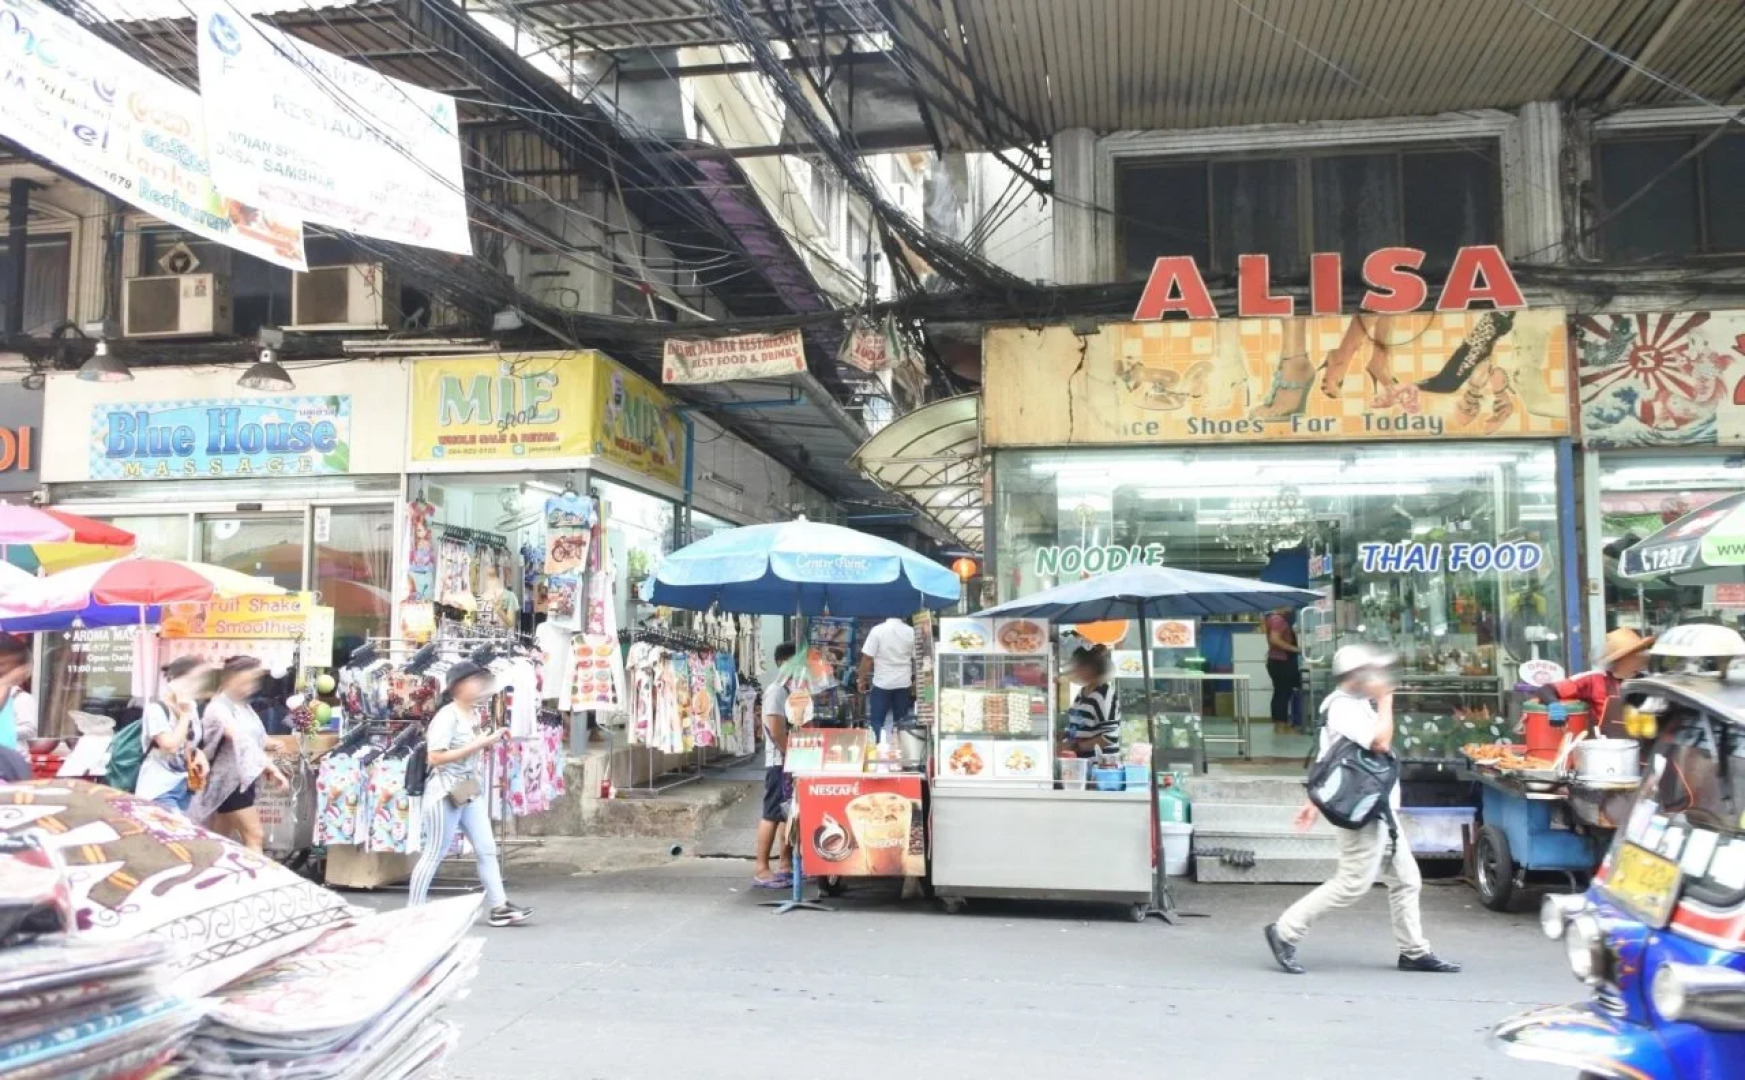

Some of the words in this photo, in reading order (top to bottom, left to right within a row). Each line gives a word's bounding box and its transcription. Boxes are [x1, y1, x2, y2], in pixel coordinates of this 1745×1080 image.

[1133, 244, 1528, 321] ALISA
[717, 355, 747, 366] FOOD
[438, 371, 560, 427] MIE
[496, 406, 539, 433] shop
[1187, 416, 1264, 435] Shoes
[1291, 414, 1337, 433] For
[1363, 411, 1444, 435] Today
[105, 411, 196, 459] Blue
[205, 407, 338, 457] House
[123, 457, 314, 477] MASSAGE
[1034, 541, 1164, 577] NOODLE
[1357, 541, 1442, 573] THAI
[1449, 541, 1544, 573] FOOD
[73, 629, 110, 641] AROMA
[215, 619, 306, 635] Smoothies
[87, 653, 110, 663] Open
[808, 781, 861, 796] NESCAFÉ
